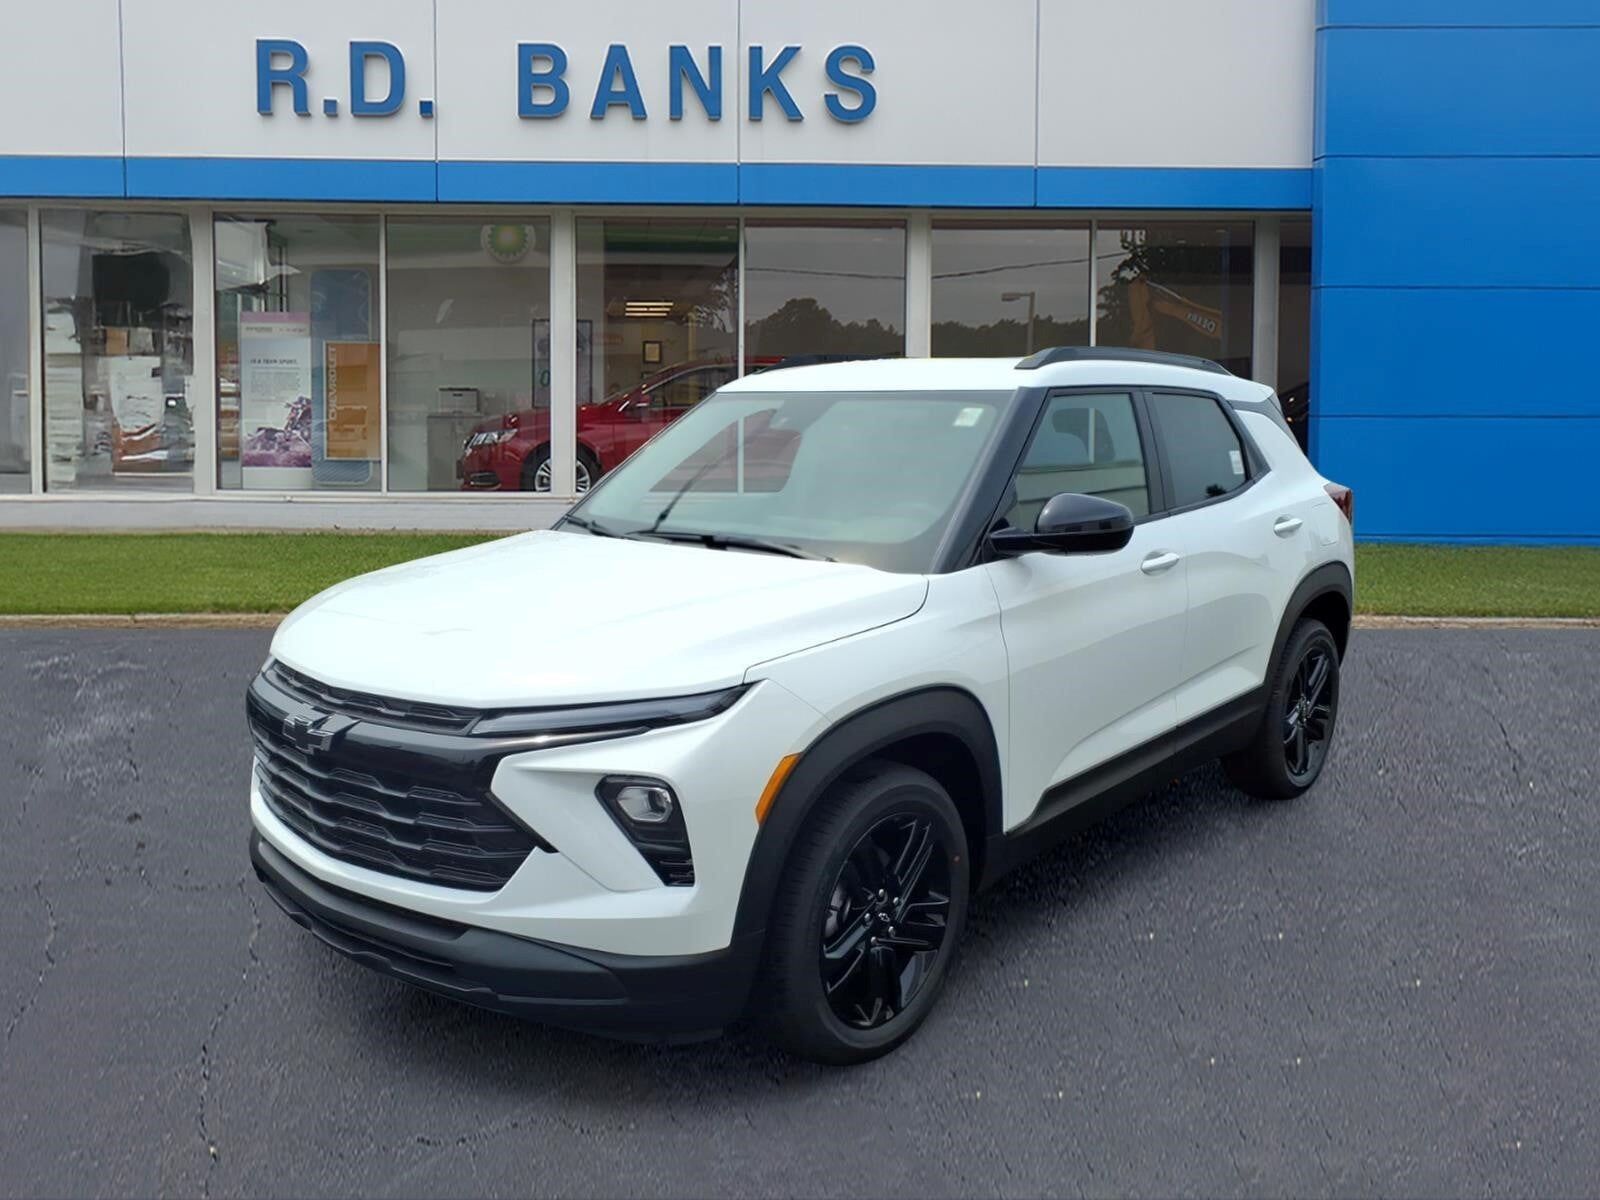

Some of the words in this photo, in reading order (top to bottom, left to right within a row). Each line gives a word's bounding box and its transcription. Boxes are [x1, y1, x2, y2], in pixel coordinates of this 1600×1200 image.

[255, 39, 436, 118] R.D.
[516, 42, 878, 125] BANKS
[328, 344, 337, 421] CHEVROLET
